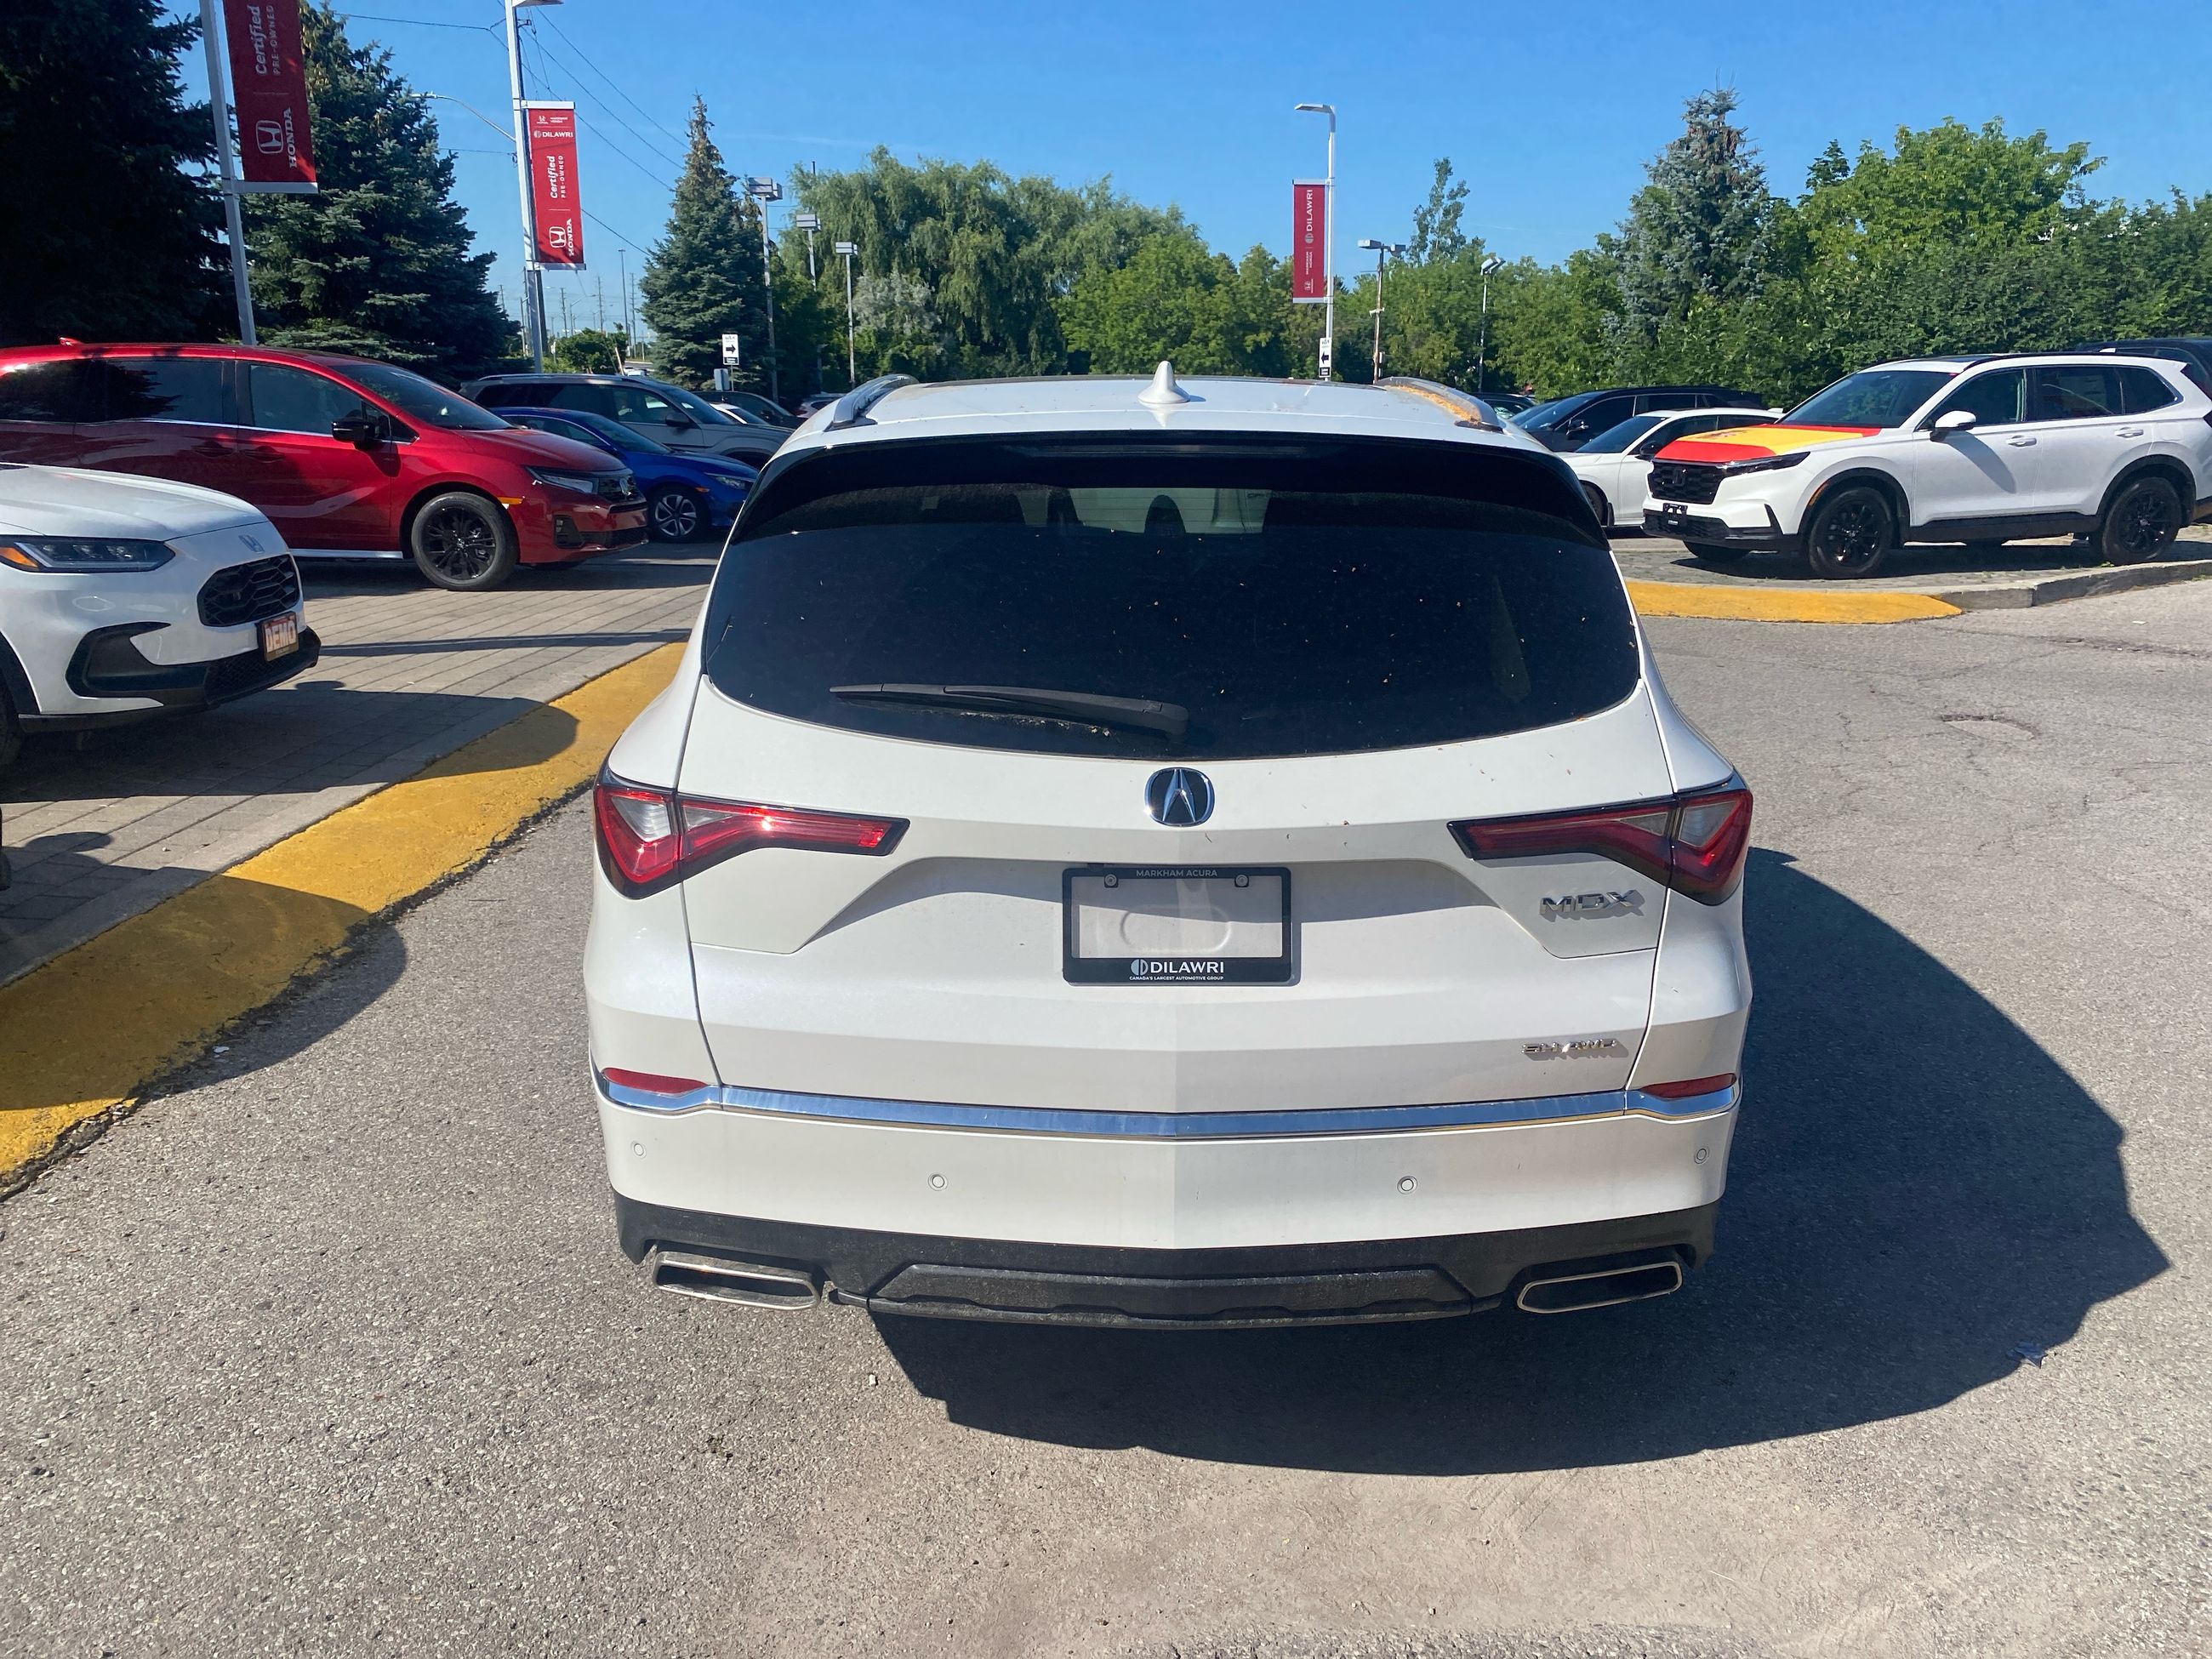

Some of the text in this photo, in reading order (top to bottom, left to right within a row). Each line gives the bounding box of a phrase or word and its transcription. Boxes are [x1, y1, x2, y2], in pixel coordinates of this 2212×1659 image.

[247, 4, 266, 76] Certified
[266, 5, 281, 75] PRE-OWNED
[283, 106, 298, 168] HONDA
[547, 156, 558, 199] Certified
[558, 155, 567, 198] PRE-OWNED
[566, 218, 574, 256] HONDA
[265, 620, 297, 653] DEMO
[1539, 889, 1638, 914] MDX
[1150, 961, 1224, 973] DILAWRI
